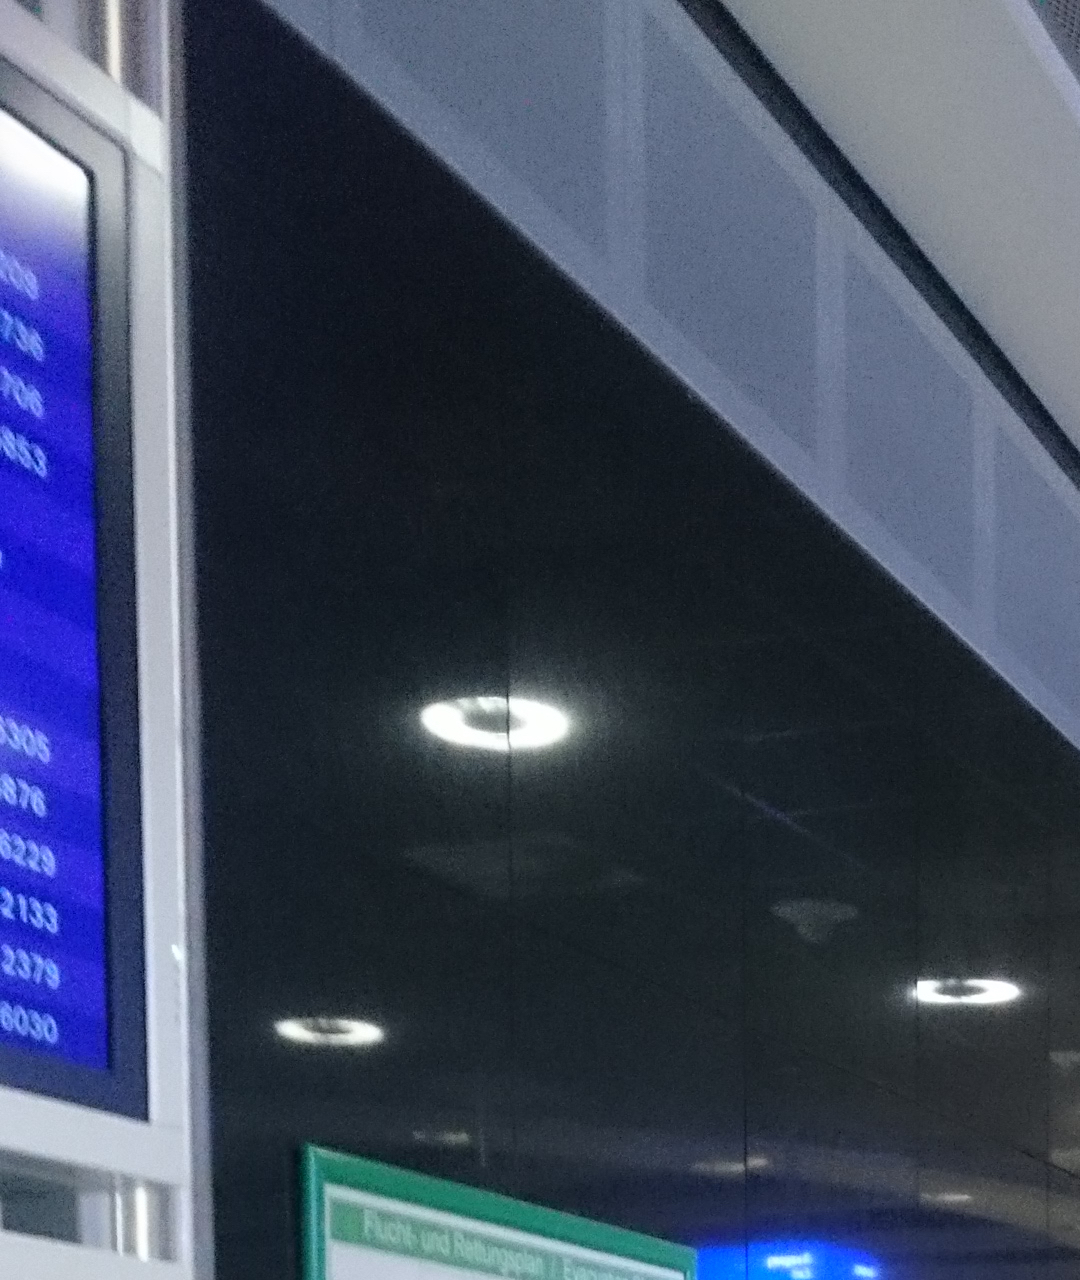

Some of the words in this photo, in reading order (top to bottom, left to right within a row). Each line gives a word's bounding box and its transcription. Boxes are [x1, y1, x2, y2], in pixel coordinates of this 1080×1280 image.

[0, 885, 60, 936] 2133
[0, 942, 61, 991] 2379
[0, 1000, 60, 1046] 6030
[420, 1229, 450, 1256] und
[453, 1230, 543, 1278] Rettungsplan
